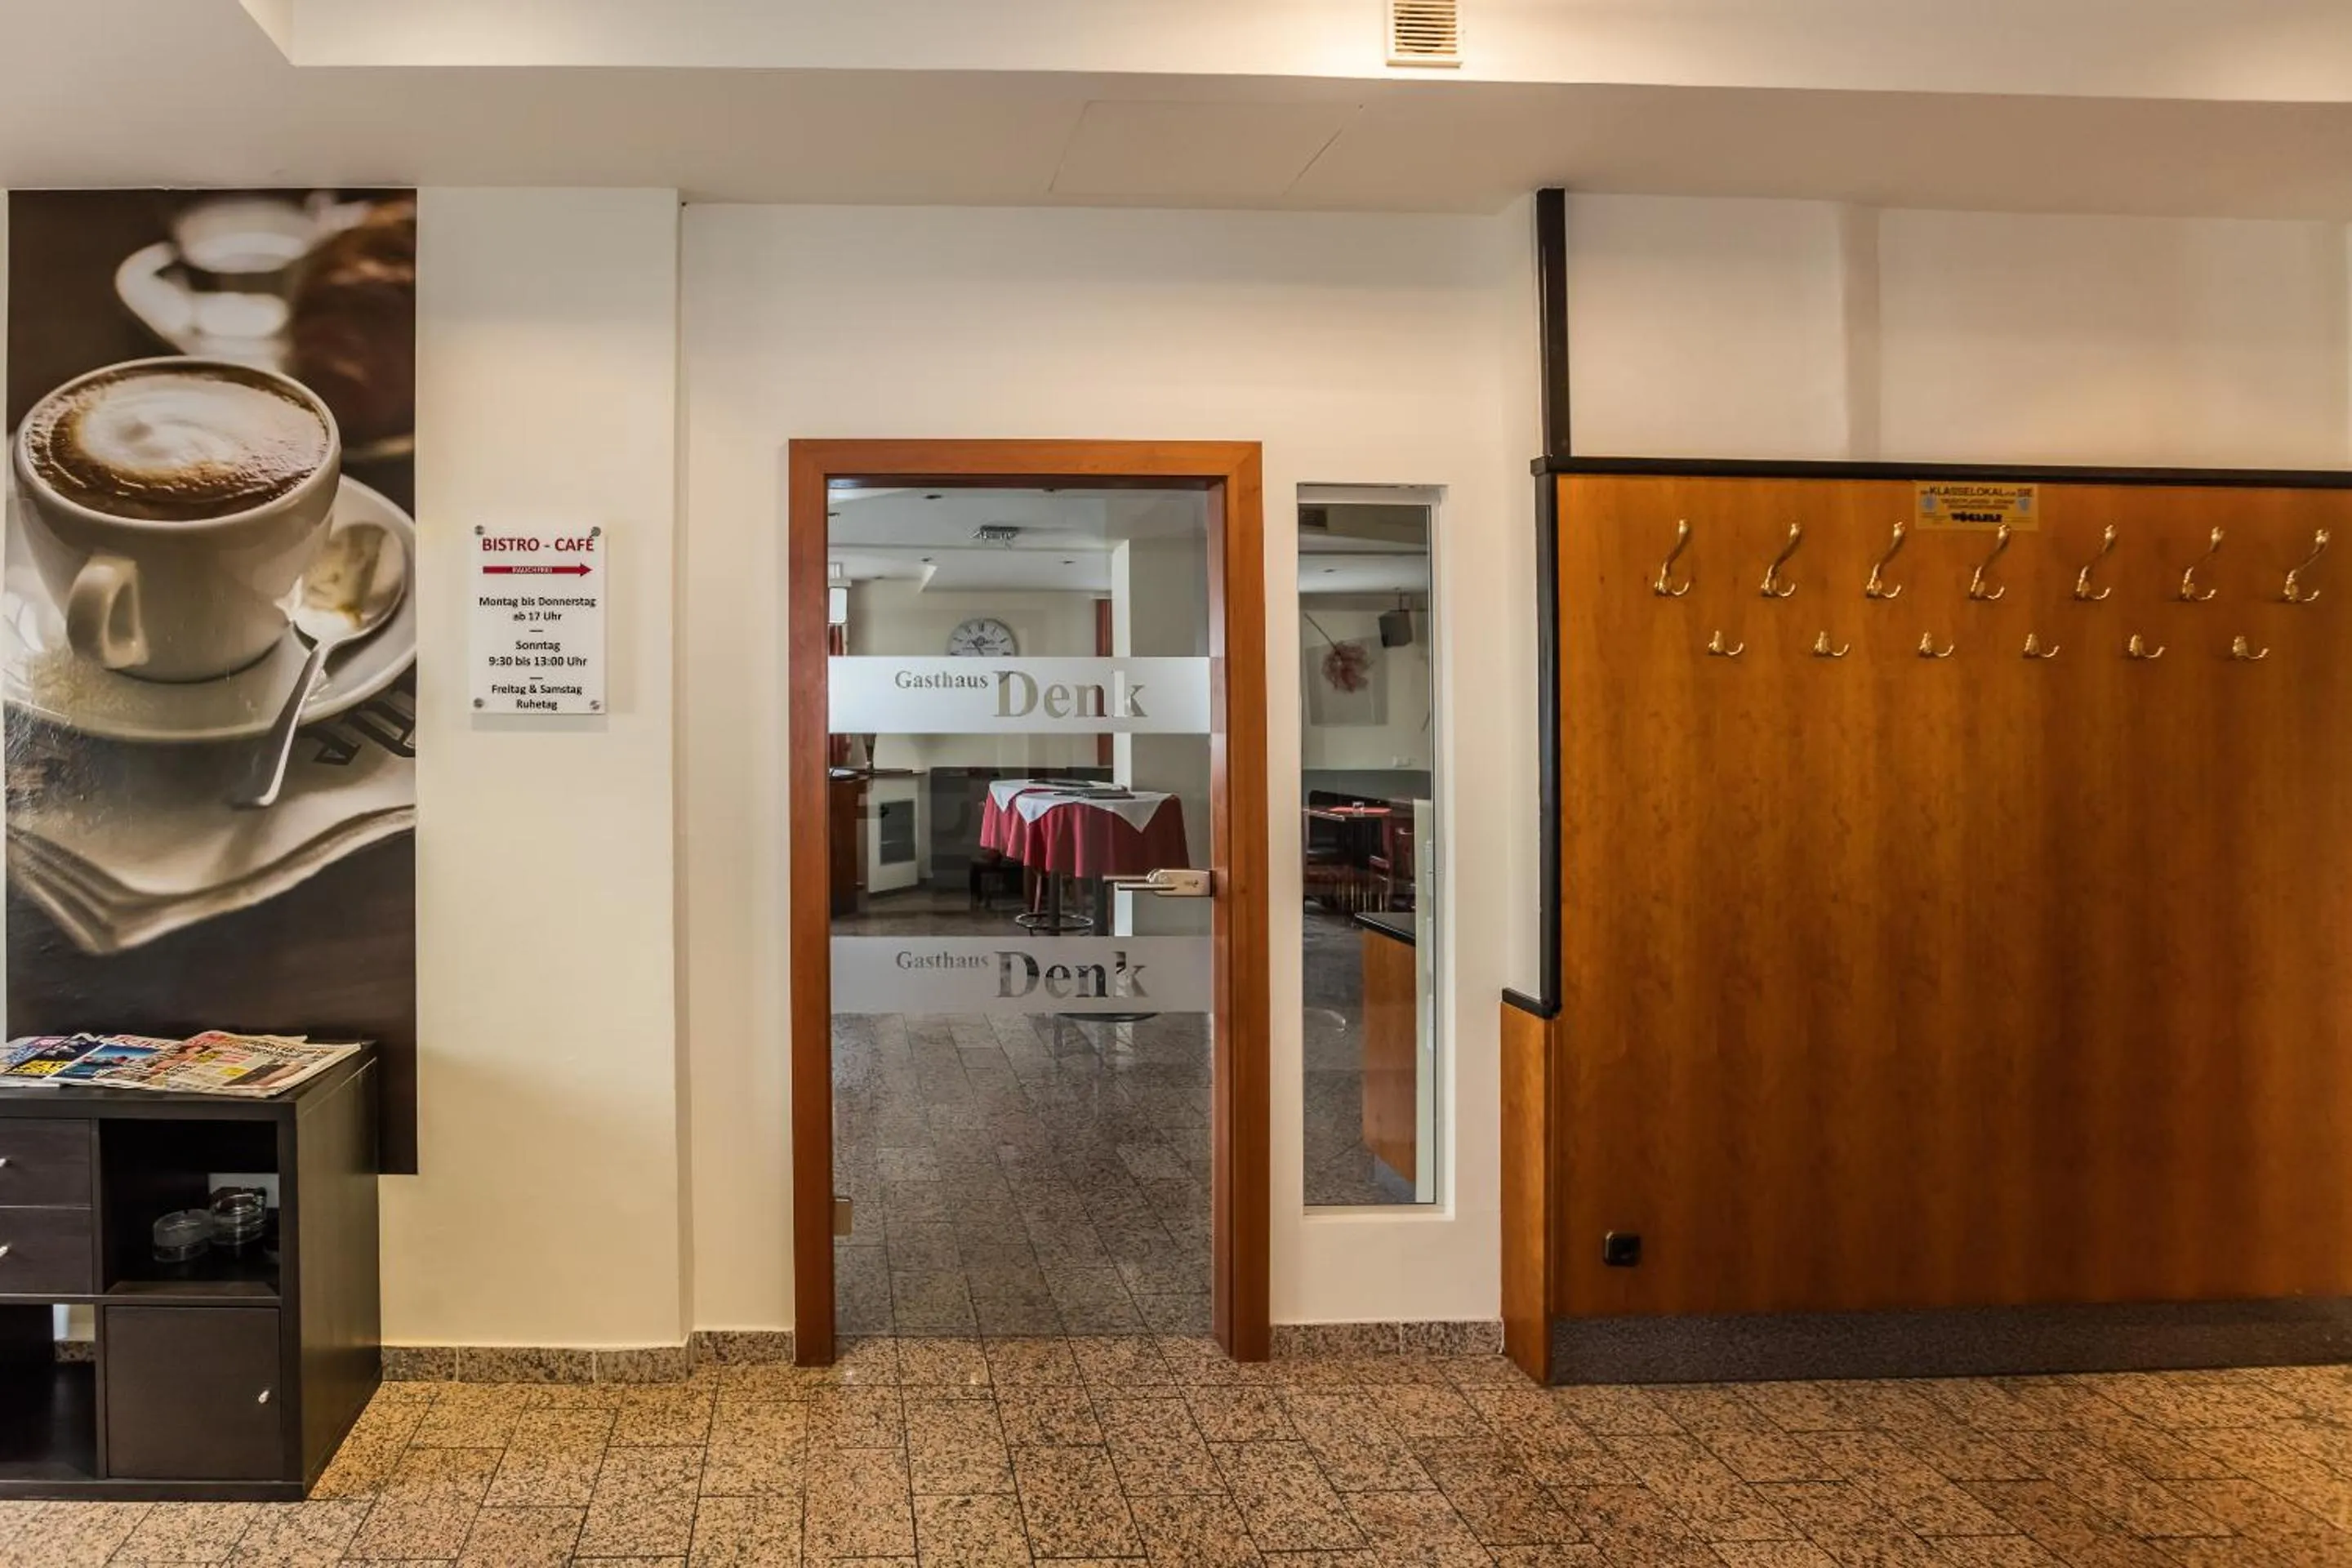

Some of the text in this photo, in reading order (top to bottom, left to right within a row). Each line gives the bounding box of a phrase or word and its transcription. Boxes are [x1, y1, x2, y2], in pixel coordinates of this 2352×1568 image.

[482, 537, 540, 552] BISTRO
[479, 596, 596, 608] Montag bis Donnerstag
[513, 611, 563, 621] ab 17 Uhr
[515, 639, 561, 653] Sonntag
[488, 655, 587, 666] 9:30 bis 13:00 Uhr
[491, 684, 583, 695] Freitag & Samstag
[894, 670, 1148, 719] Gasthaus Denk
[515, 698, 559, 710] Ruhetag
[895, 951, 1149, 1000] Gasthaus Denk
